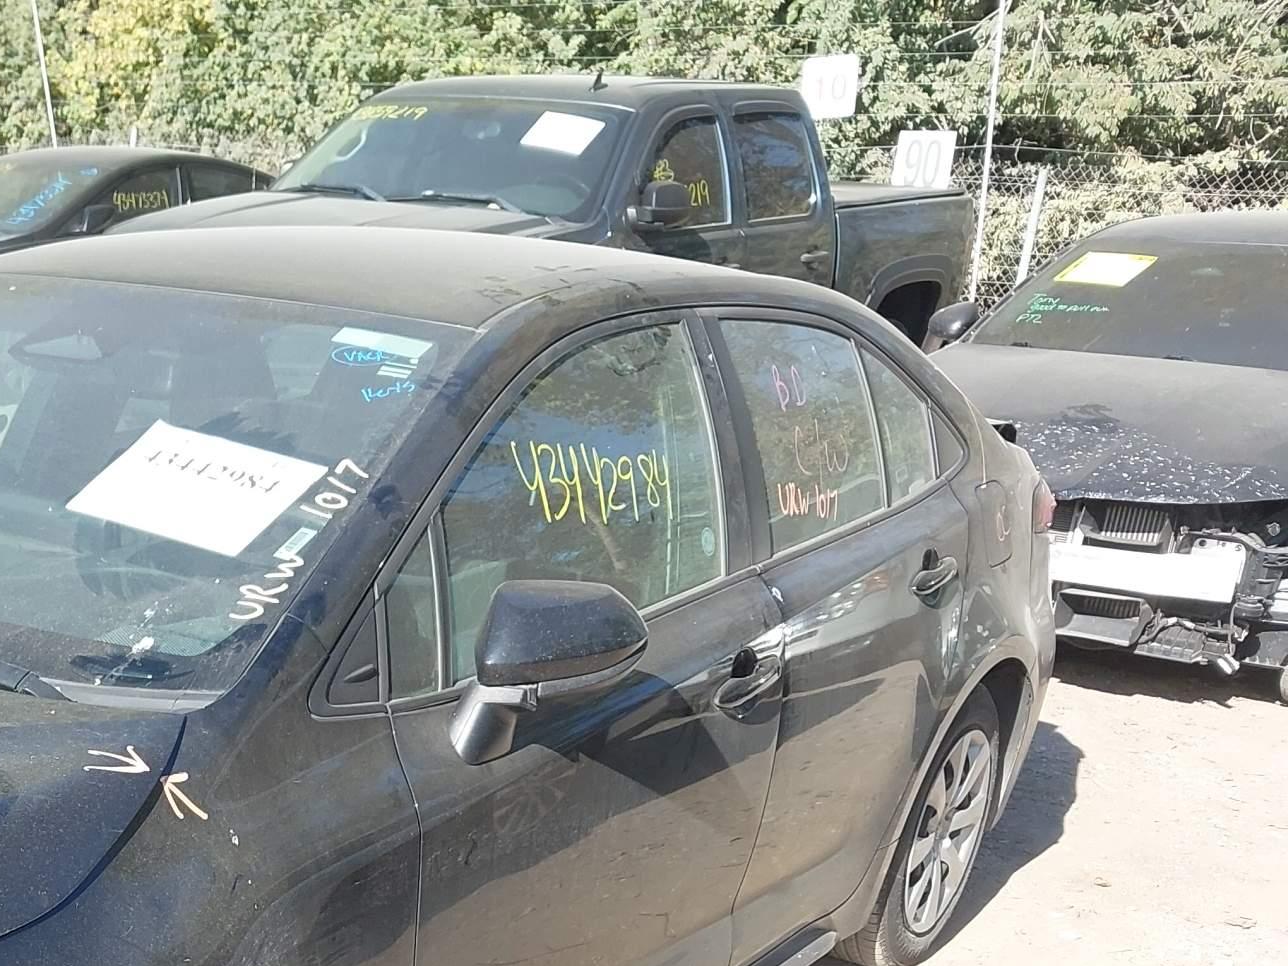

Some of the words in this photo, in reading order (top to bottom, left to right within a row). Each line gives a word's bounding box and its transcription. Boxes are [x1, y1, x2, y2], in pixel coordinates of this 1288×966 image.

[905, 139, 941, 185] 90
[299, 457, 370, 520] 1017
[510, 440, 674, 525] 43442984
